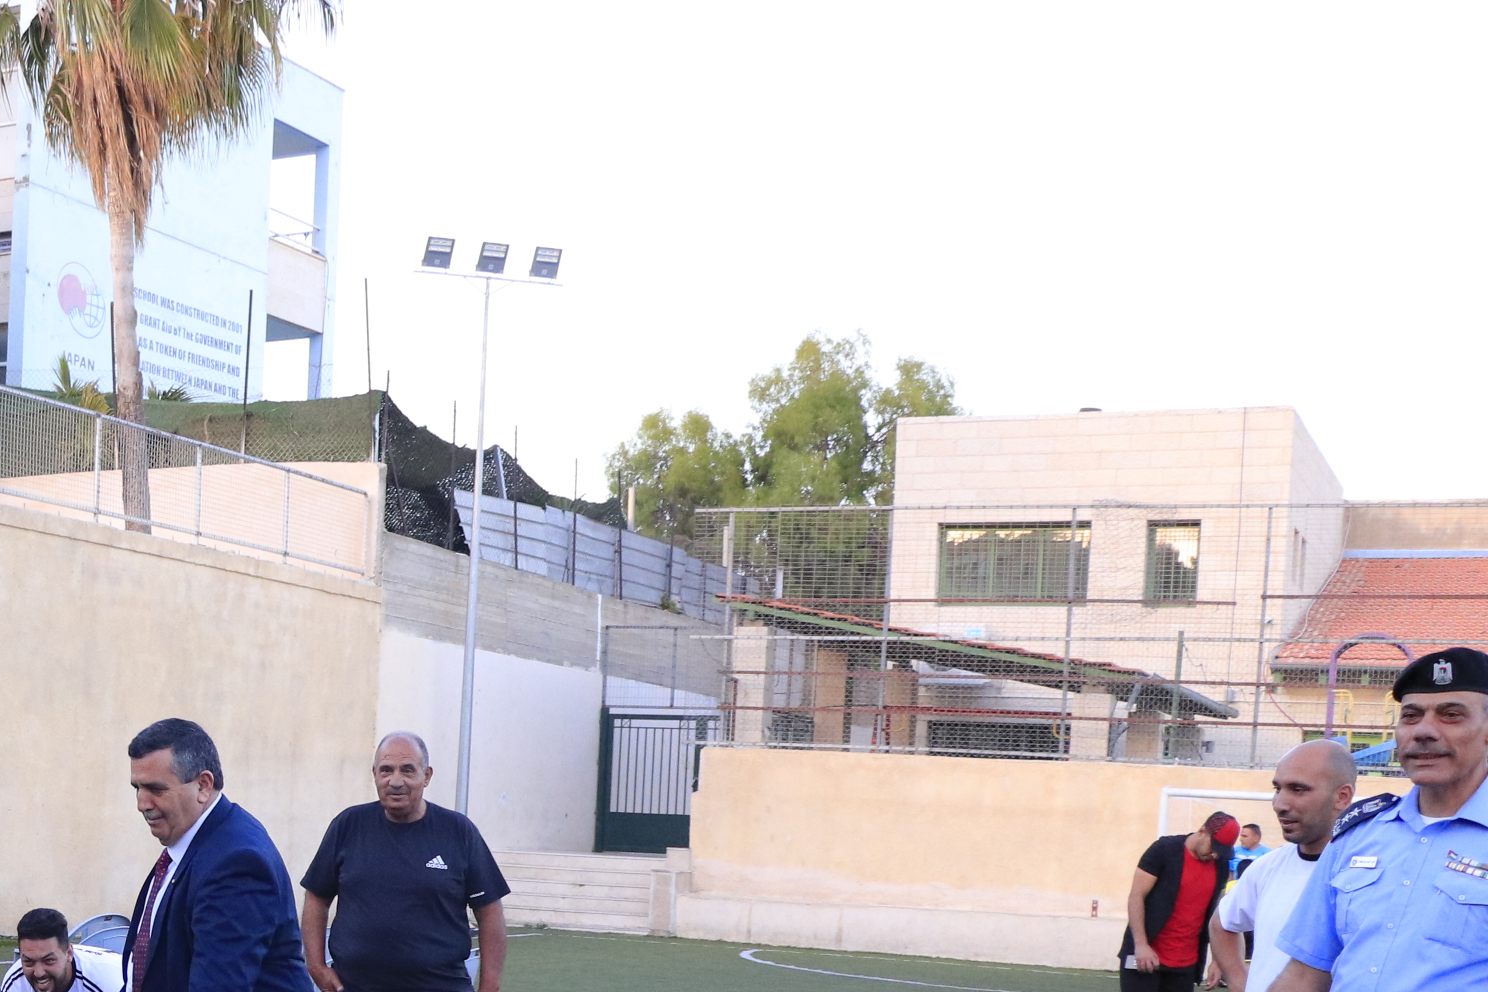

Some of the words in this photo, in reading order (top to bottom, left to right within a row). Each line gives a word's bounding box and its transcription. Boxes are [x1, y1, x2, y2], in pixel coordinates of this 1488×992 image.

[133, 286, 159, 305] SCHOOL
[160, 295, 175, 311] WAS
[176, 301, 220, 327] CONSTRUCTED
[220, 317, 227, 329] IN
[227, 321, 243, 334] 2001
[139, 313, 161, 330] GRANT
[195, 332, 234, 354] GOVERNMENT
[234, 344, 242, 356] OF
[64, 351, 95, 372] APAN
[149, 340, 154, 352] A
[154, 341, 177, 359] TOKEN
[178, 348, 186, 361] OF
[187, 351, 226, 373] FRIENDSHIP
[227, 363, 240, 378] AND
[193, 376, 213, 392] JAPAN
[213, 382, 227, 396] AND
[227, 386, 240, 400] THE
